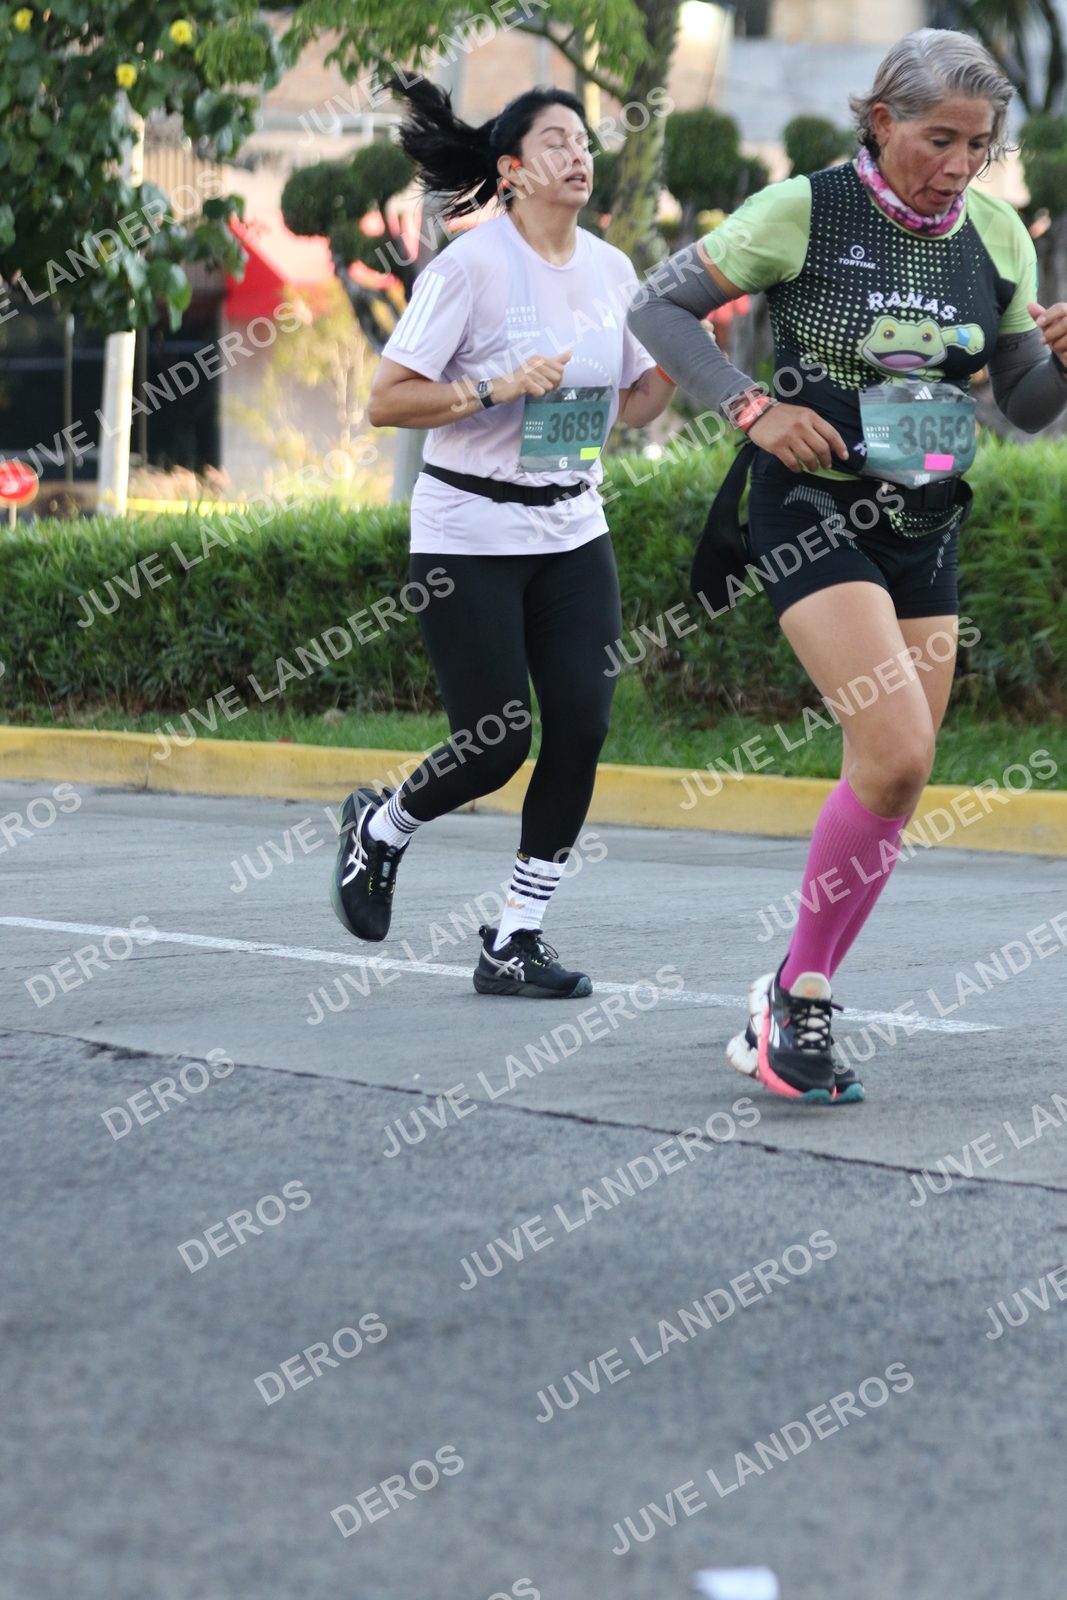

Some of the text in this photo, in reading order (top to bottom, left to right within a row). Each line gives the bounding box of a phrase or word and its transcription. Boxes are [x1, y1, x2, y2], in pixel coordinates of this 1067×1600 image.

[867, 291, 957, 320] RANAS
[546, 410, 604, 444] 3689
[897, 415, 973, 455] 3659
